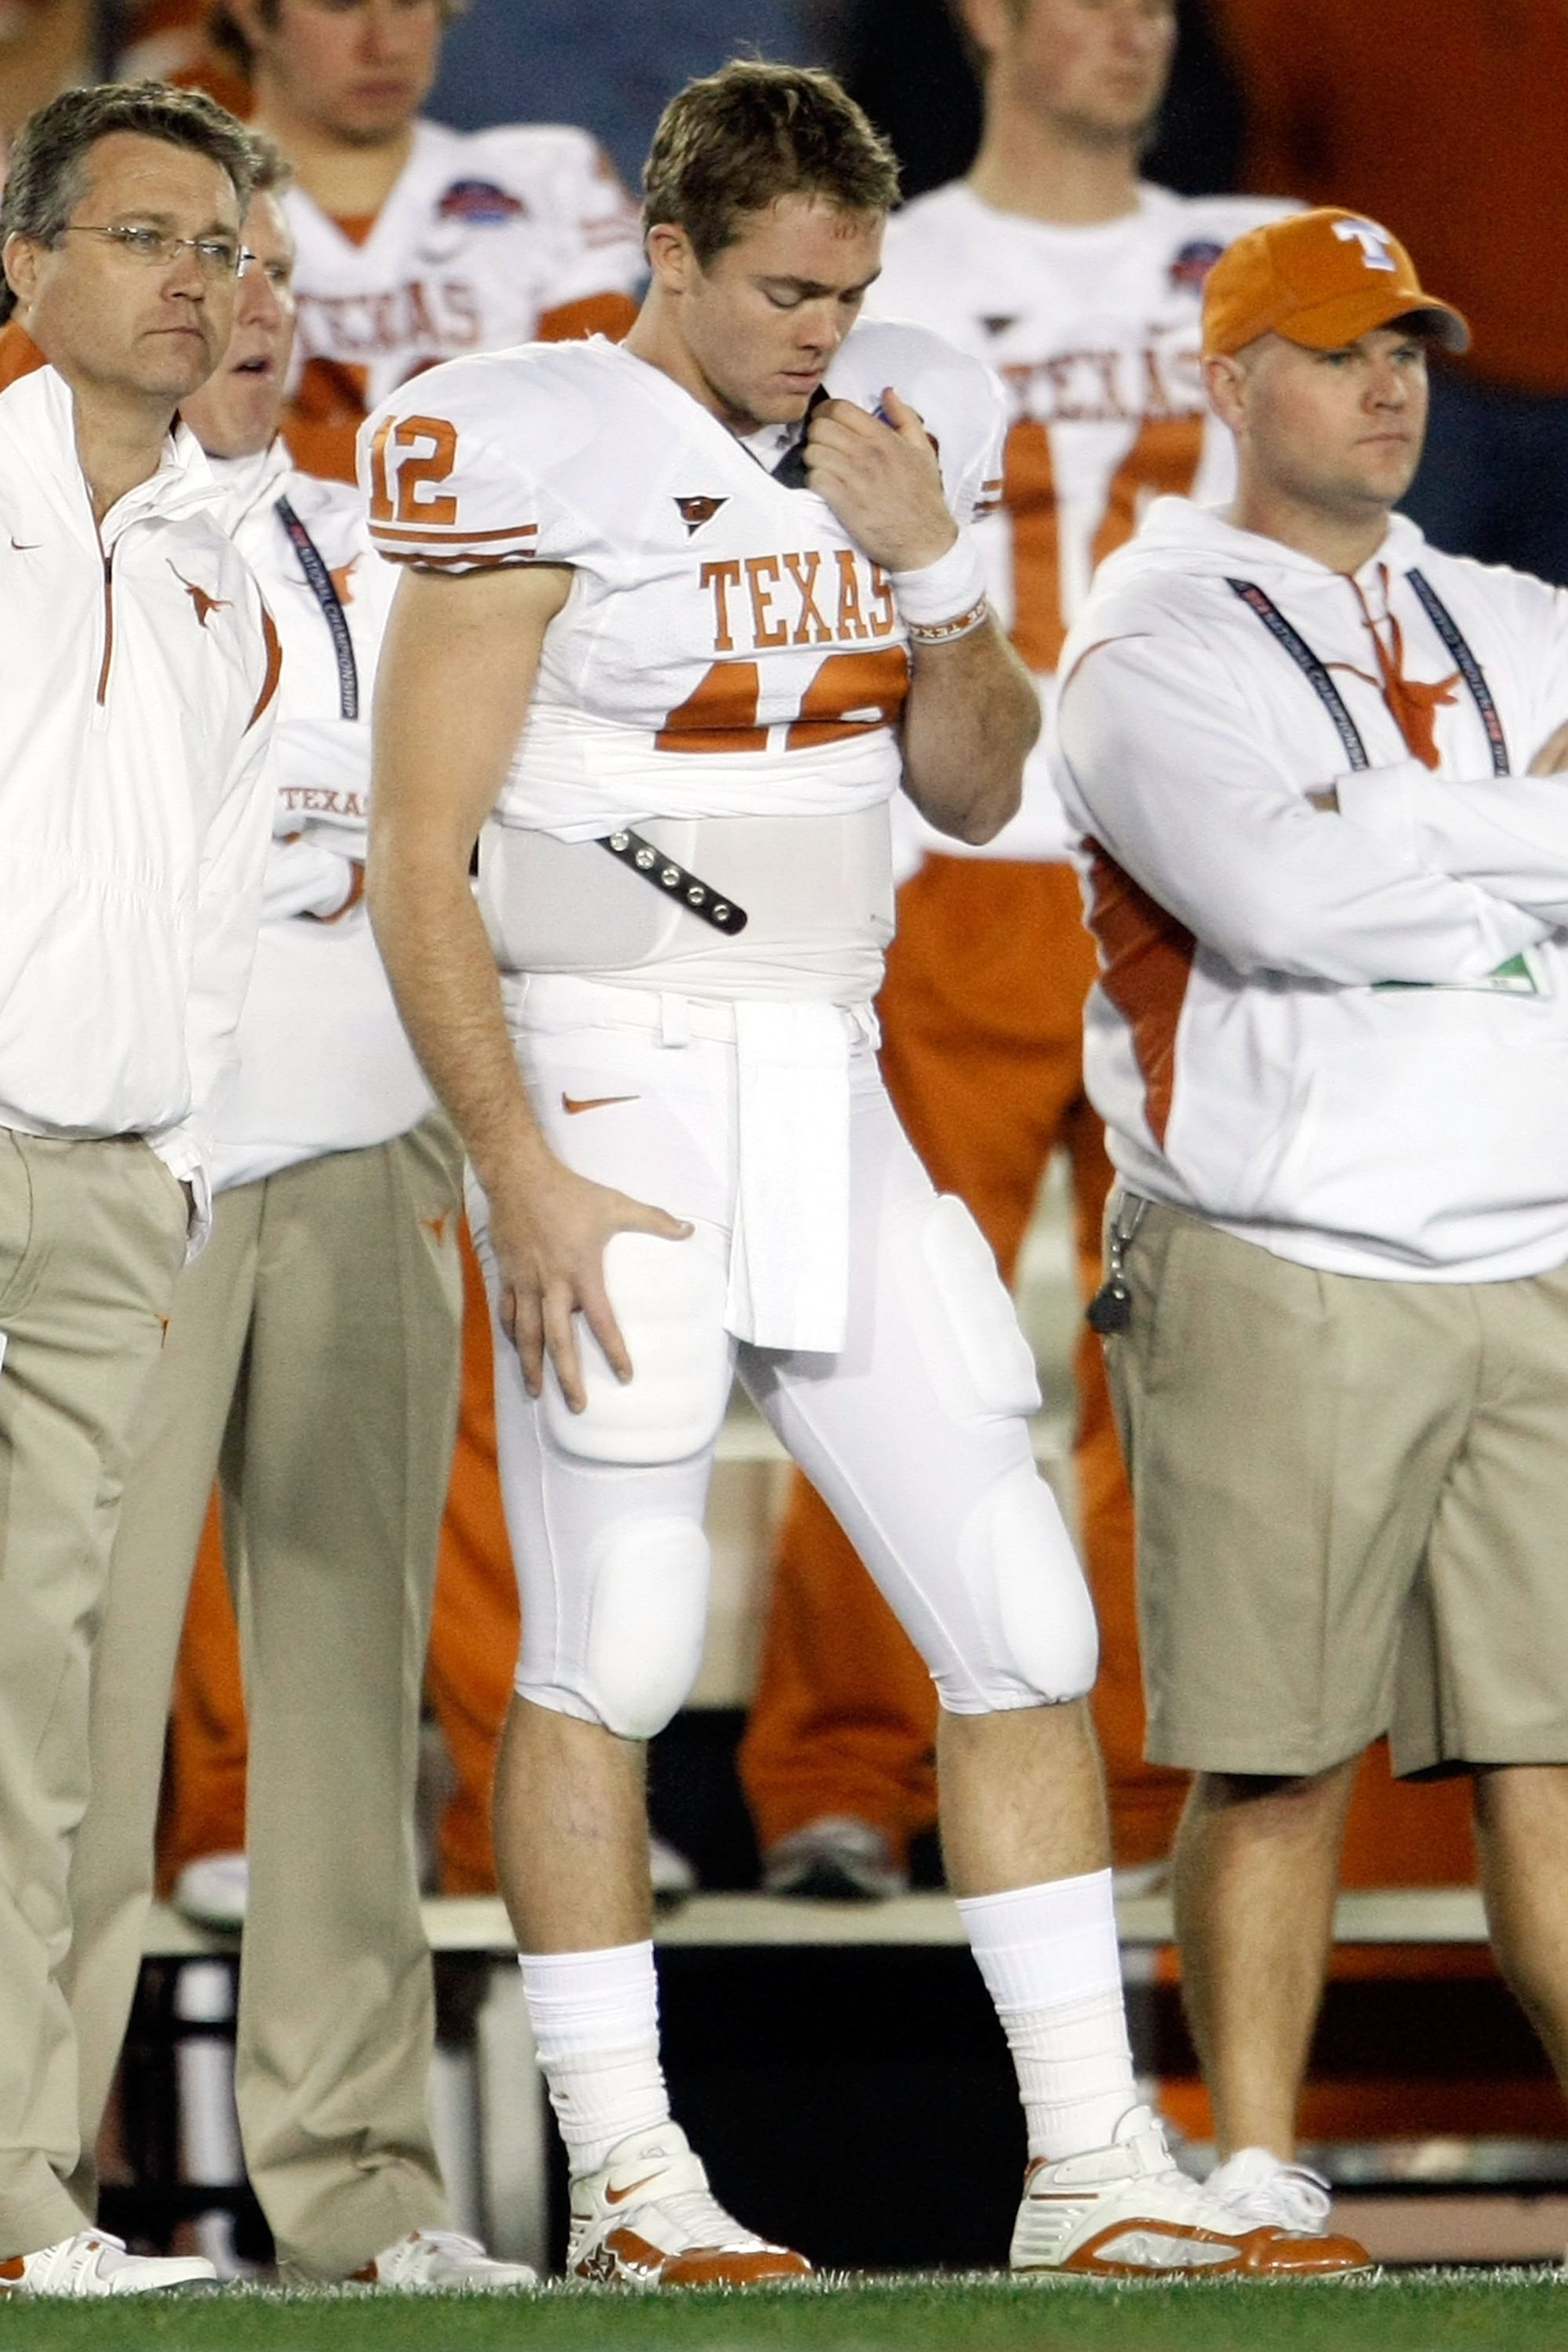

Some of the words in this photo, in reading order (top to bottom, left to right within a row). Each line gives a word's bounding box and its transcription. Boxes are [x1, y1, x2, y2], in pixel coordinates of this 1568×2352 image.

[1331, 220, 1396, 271] T
[370, 415, 458, 526] 12
[303, 546, 336, 604] NATIONAL
[324, 603, 355, 718] CHAMPIONSHIP
[699, 549, 895, 652] TEXAS
[279, 786, 369, 817] TEXA
